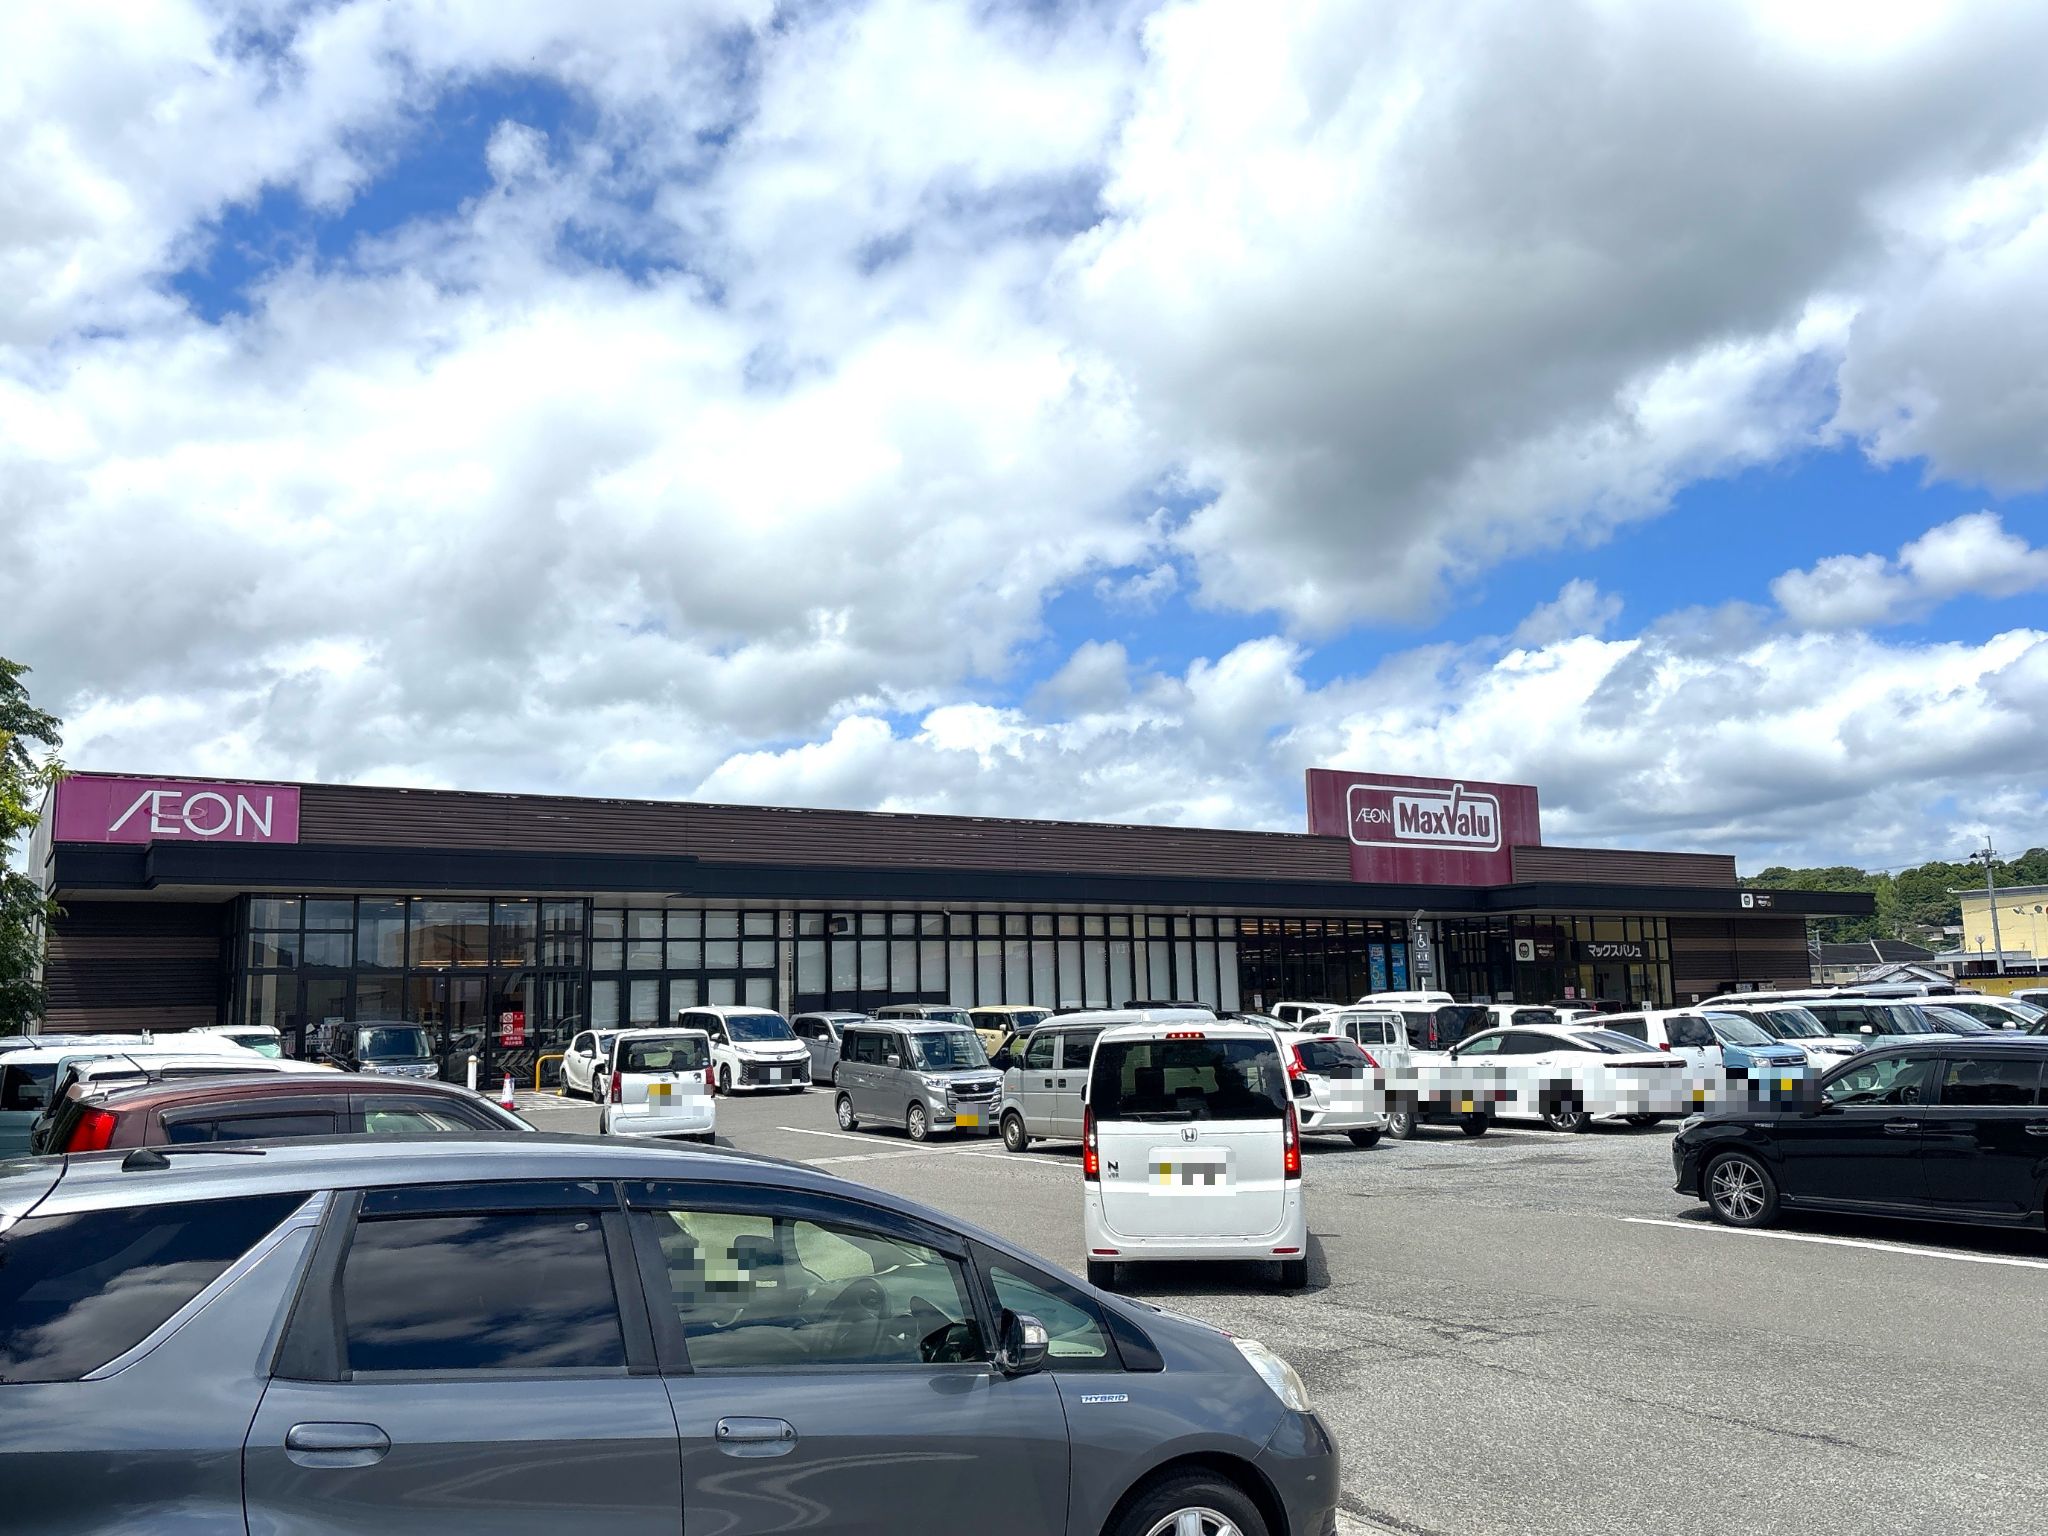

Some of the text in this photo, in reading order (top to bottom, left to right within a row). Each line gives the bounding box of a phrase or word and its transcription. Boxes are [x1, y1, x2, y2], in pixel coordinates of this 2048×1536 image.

[1399, 786, 1490, 837] MaxValu
[1588, 944, 1642, 957] マックスバリュ
